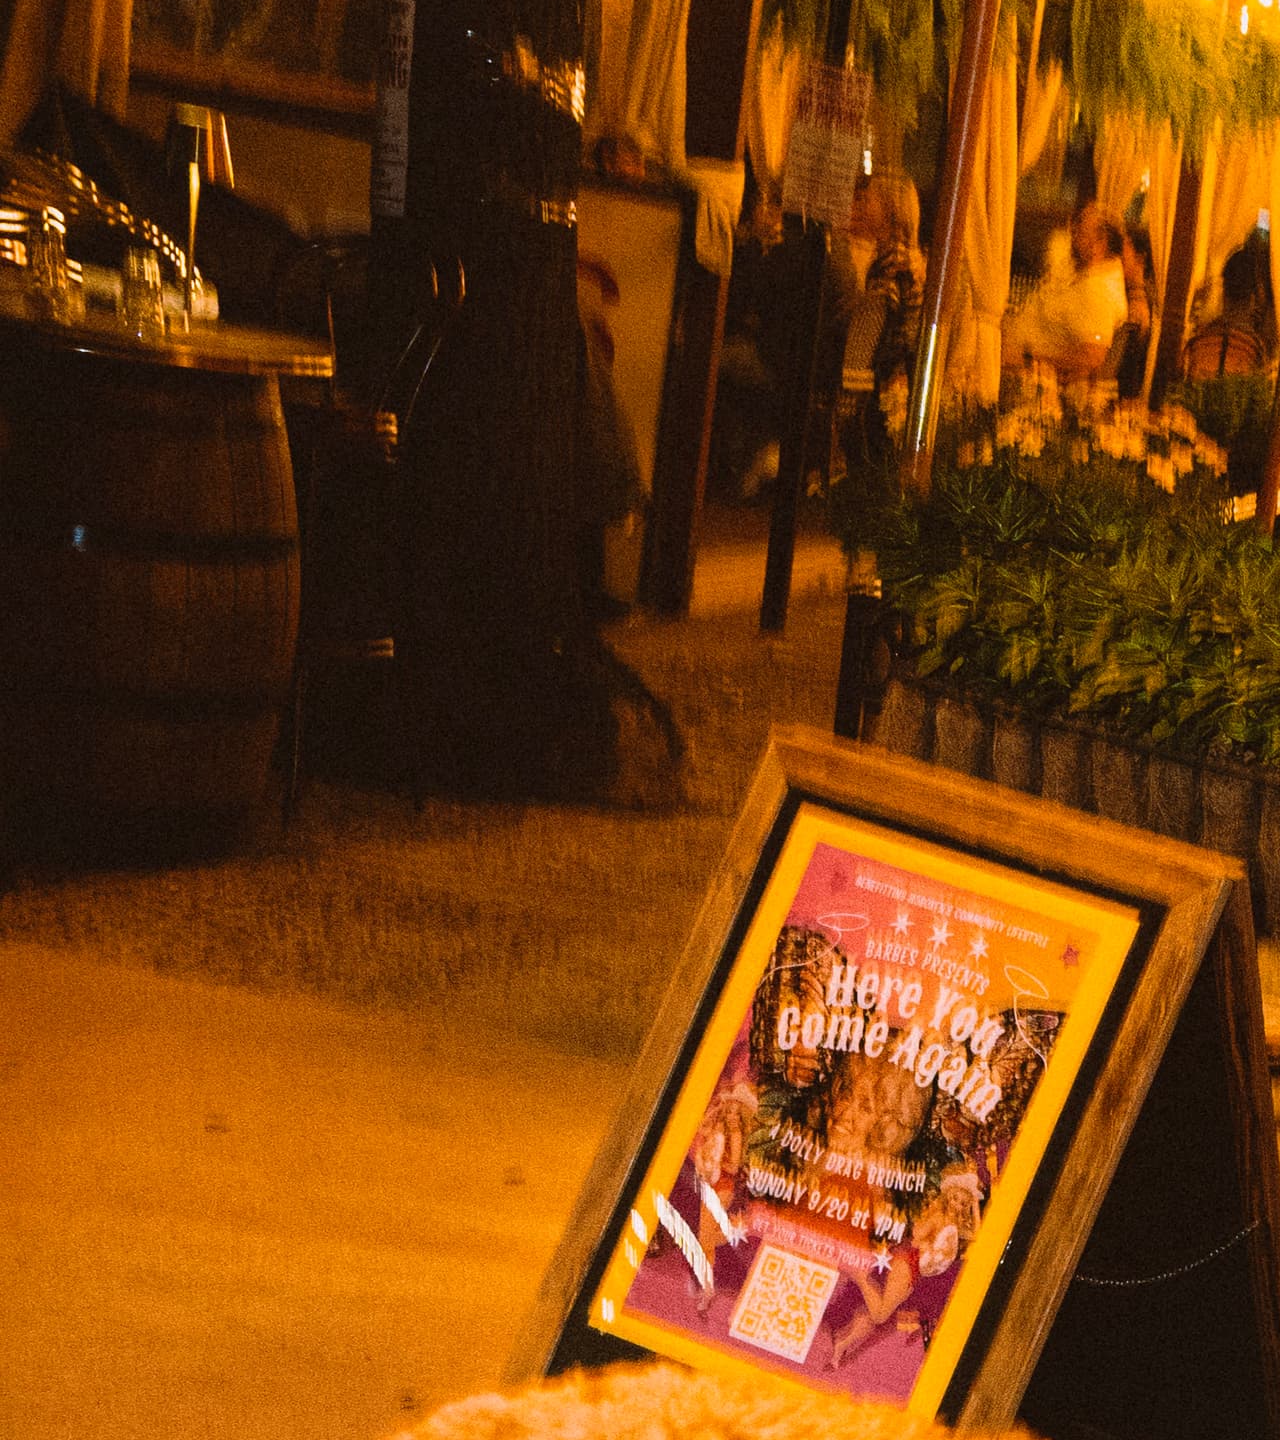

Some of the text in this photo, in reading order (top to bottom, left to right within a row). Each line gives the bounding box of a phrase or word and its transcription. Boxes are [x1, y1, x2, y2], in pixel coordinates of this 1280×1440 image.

[855, 876, 907, 903] BENEFITTING
[921, 953, 990, 996] PRESENTS
[826, 964, 1005, 1059] Here You
[778, 1006, 1002, 1124] Come Again
[769, 1123, 927, 1193] A DOLLY DRAG BRUNCH
[746, 1167, 907, 1244] SUNDAY 9/20 at 1PM
[774, 1223, 797, 1242] YOUR
[801, 1235, 835, 1258] TICKETS
